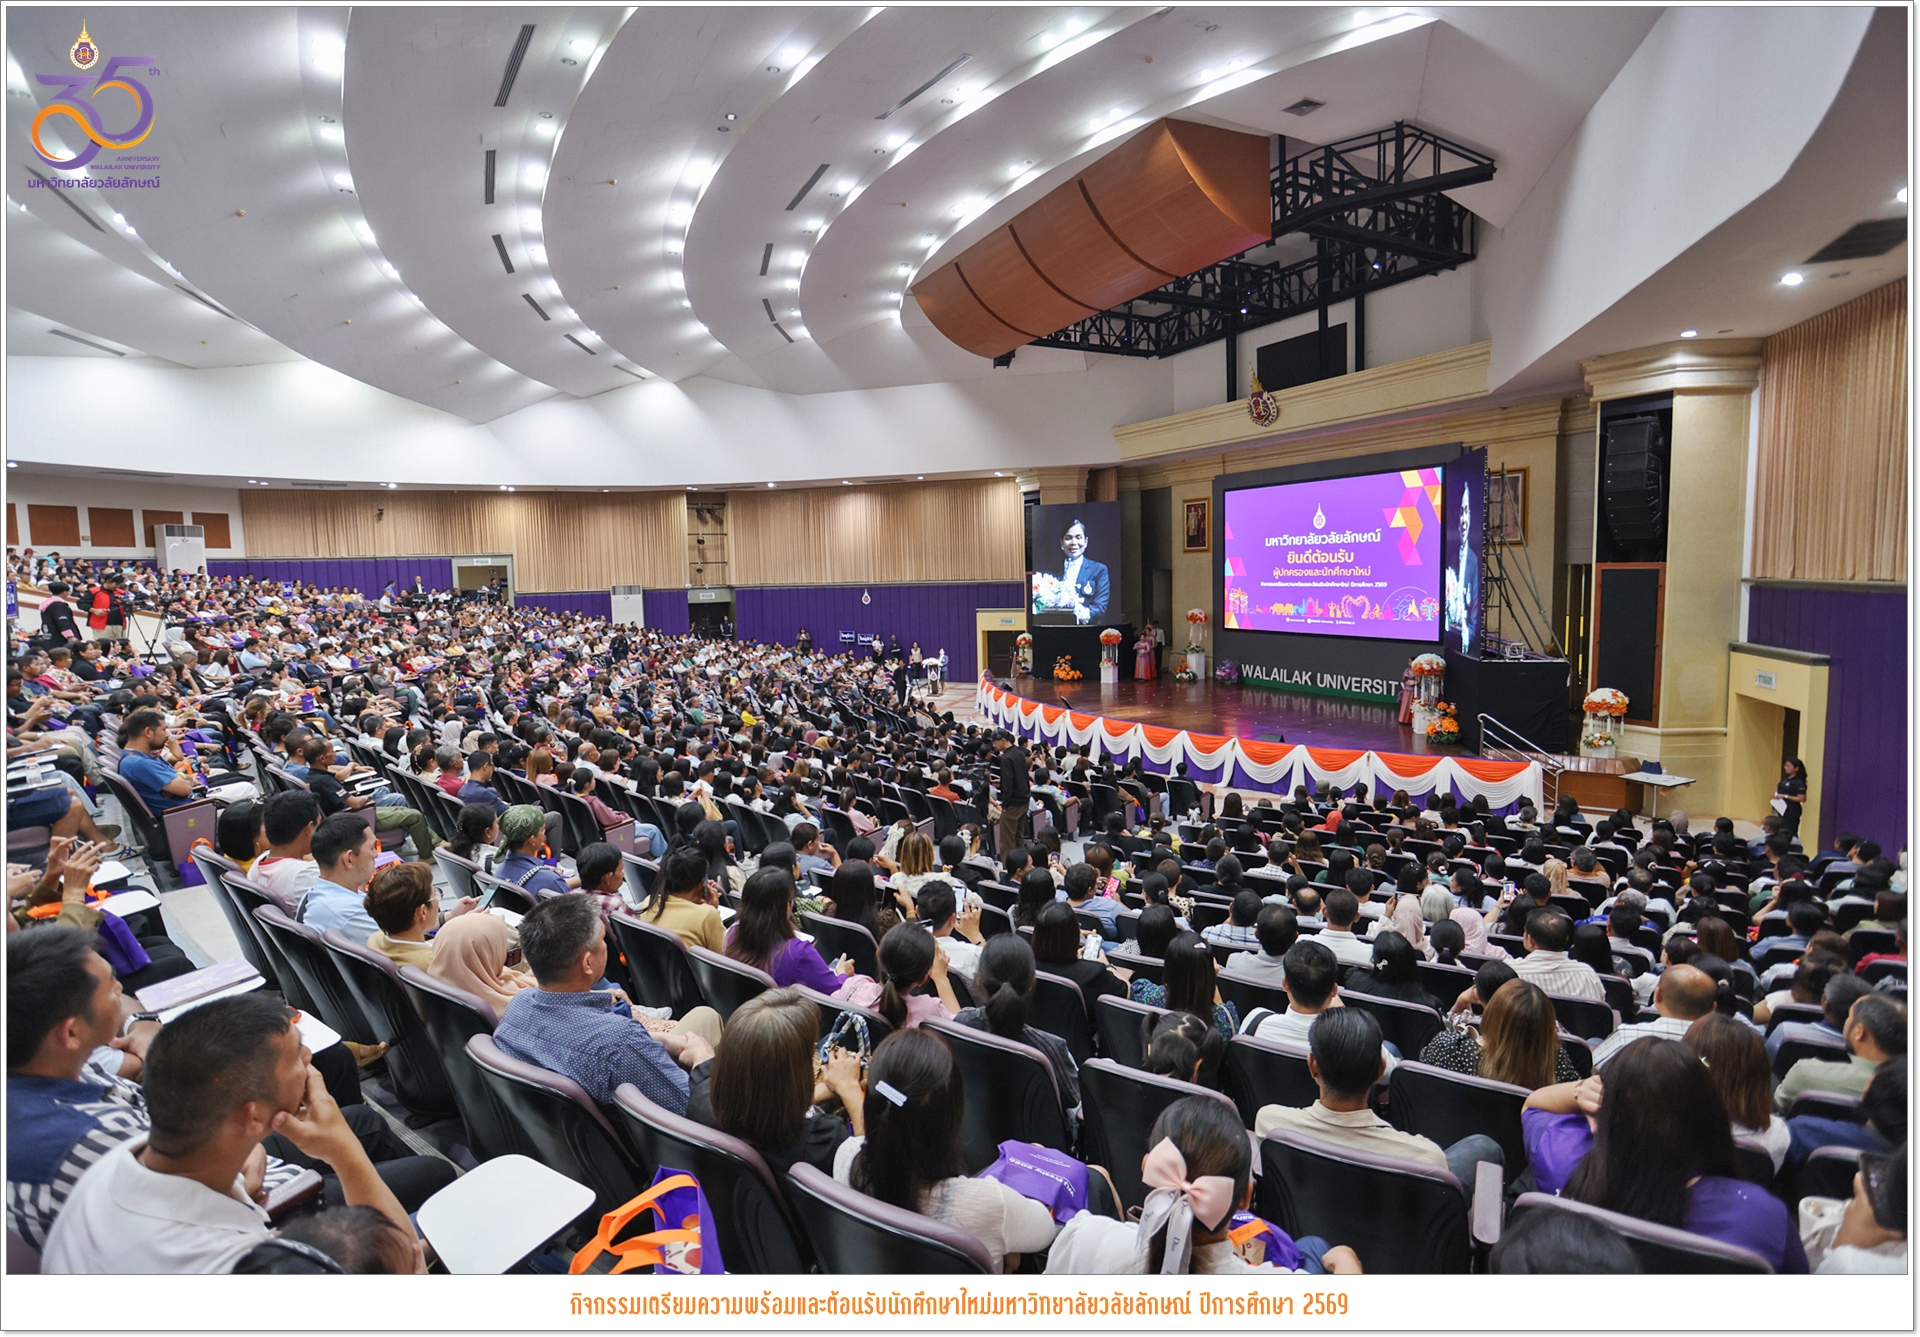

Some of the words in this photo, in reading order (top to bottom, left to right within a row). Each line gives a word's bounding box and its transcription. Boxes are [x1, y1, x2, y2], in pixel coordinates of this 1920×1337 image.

[1265, 528, 1382, 546] มหาวิทยาลัยวลัยลักษณ์
[1287, 548, 1354, 564] ยินดีต้อนรับ
[1273, 566, 1371, 579] ผู้ปกครองและนักศึกษาใหม่
[1241, 664, 1312, 685] WALAILAK
